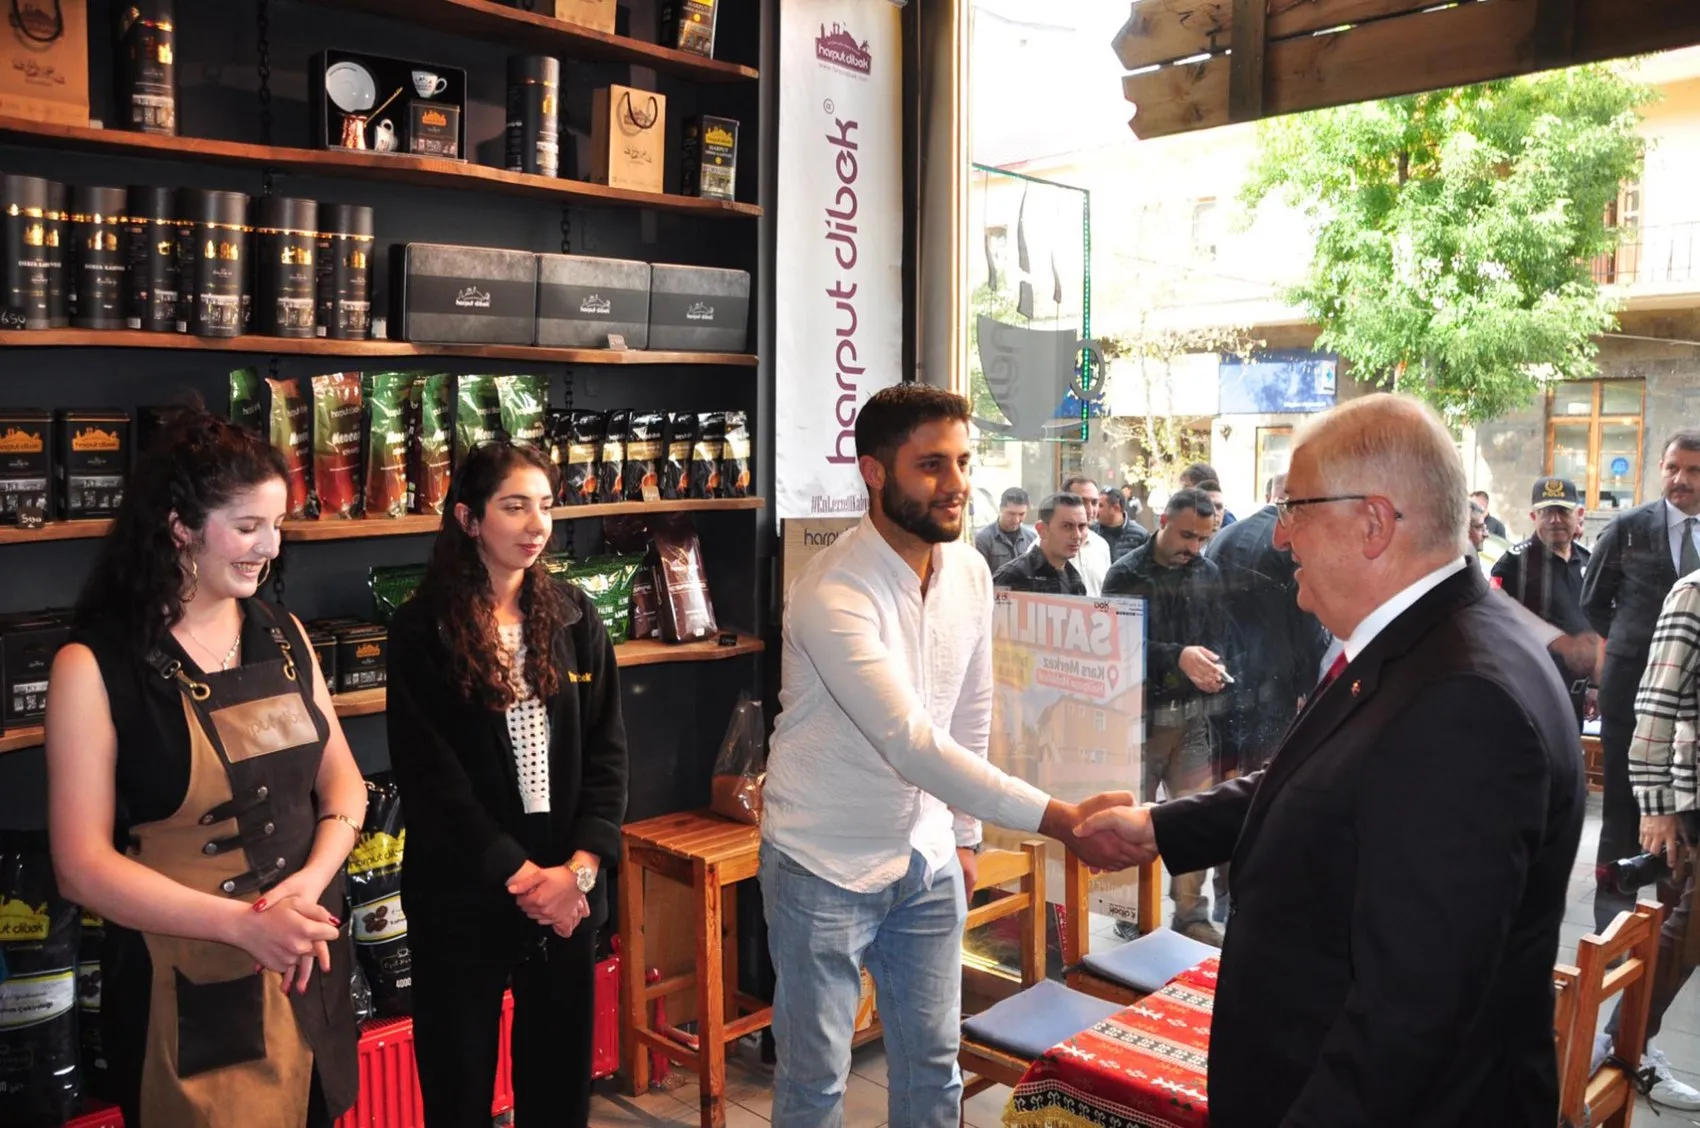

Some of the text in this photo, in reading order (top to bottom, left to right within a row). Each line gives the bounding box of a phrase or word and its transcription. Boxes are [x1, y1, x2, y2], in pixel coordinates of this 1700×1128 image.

[818, 43, 846, 62] harput
[825, 117, 858, 270] dibek
[825, 283, 865, 465] harput
